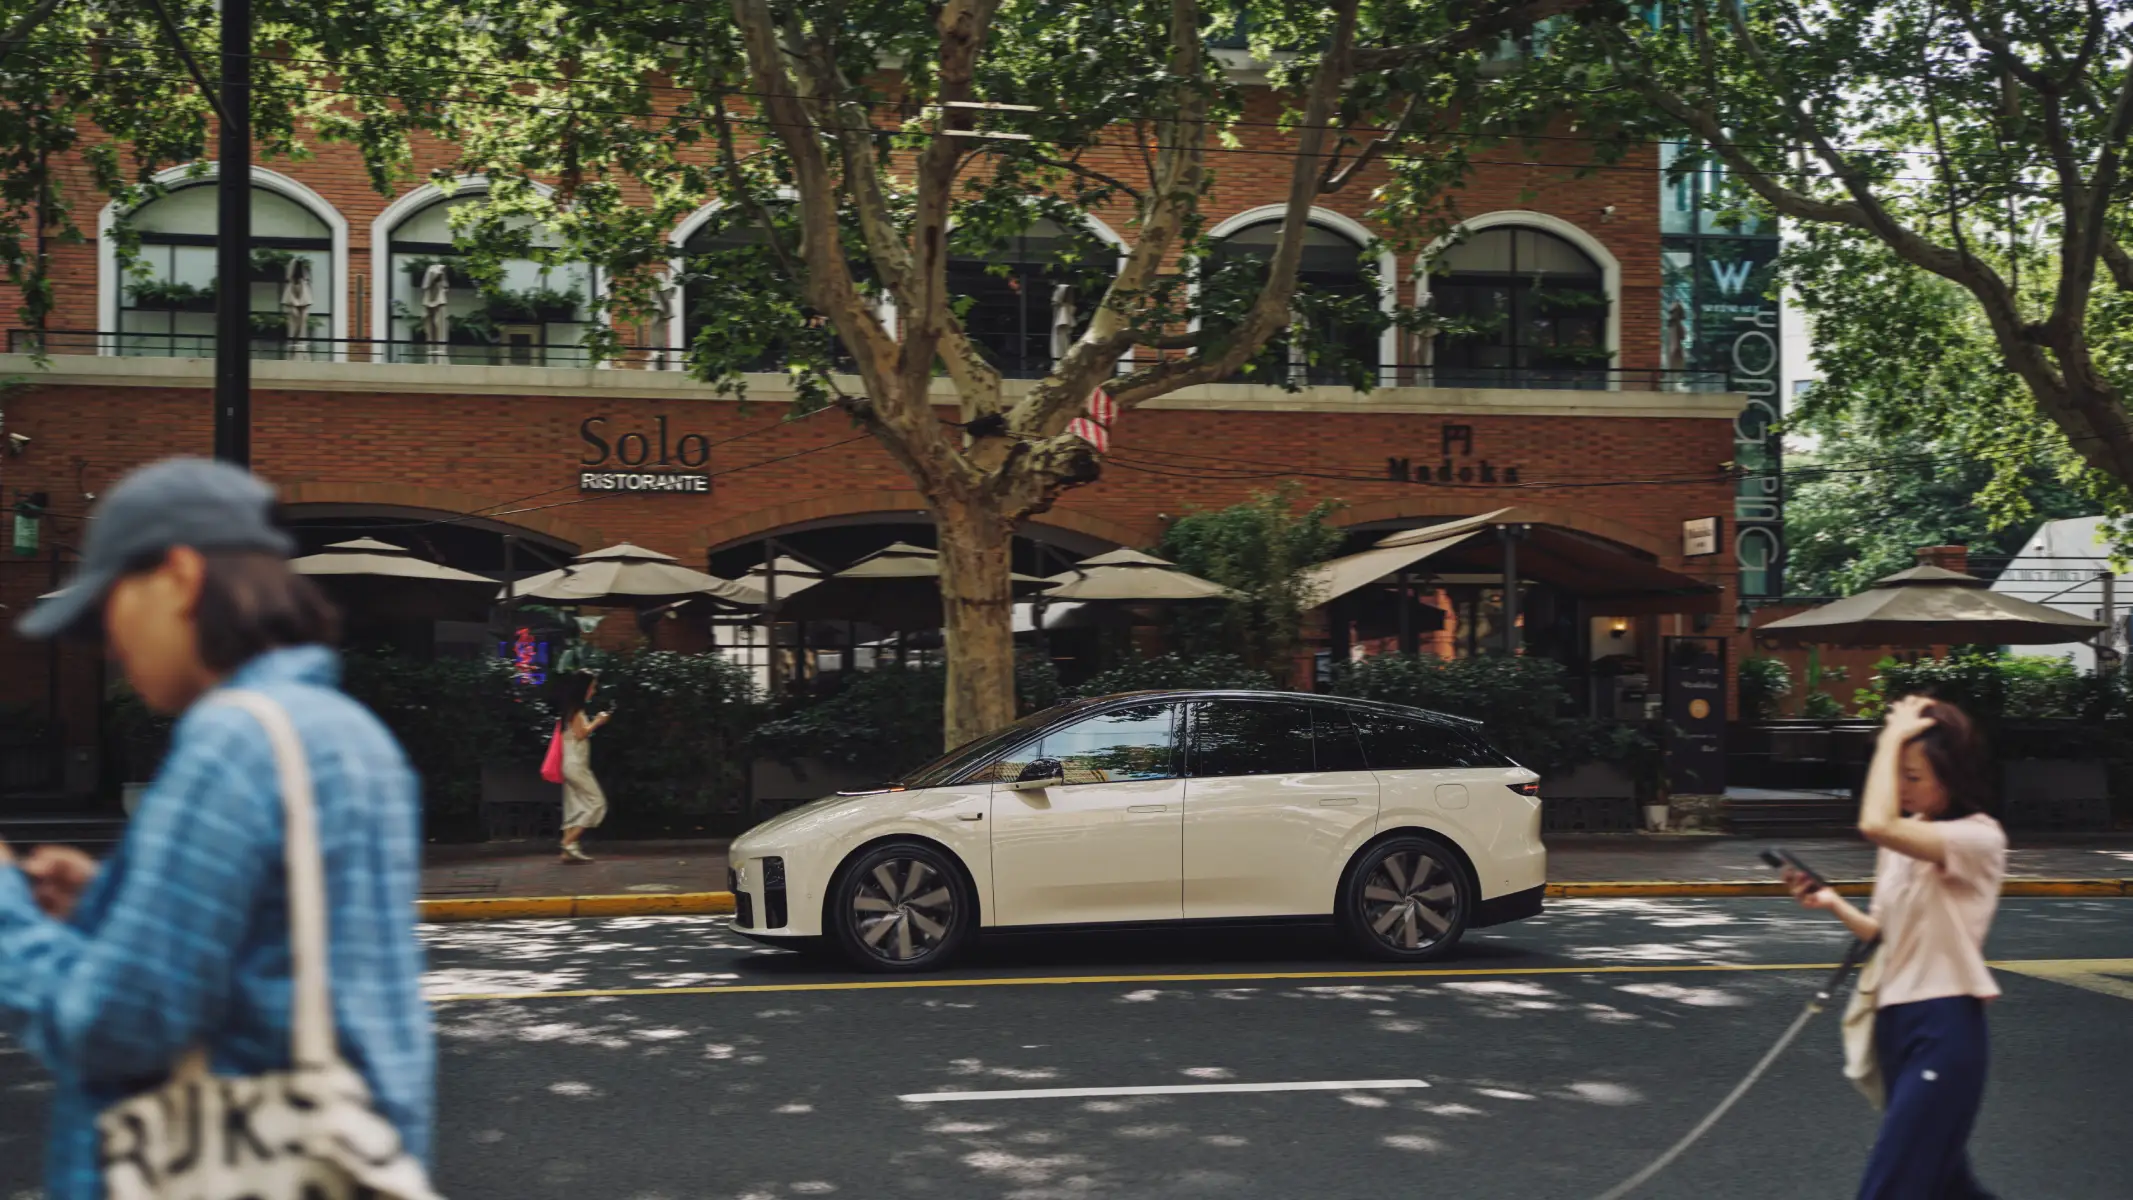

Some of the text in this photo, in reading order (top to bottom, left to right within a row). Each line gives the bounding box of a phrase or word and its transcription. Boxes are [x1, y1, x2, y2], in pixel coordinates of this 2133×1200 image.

[1709, 259, 1754, 295] W
[579, 415, 710, 468] Solo
[580, 473, 709, 492] RISTORANTE
